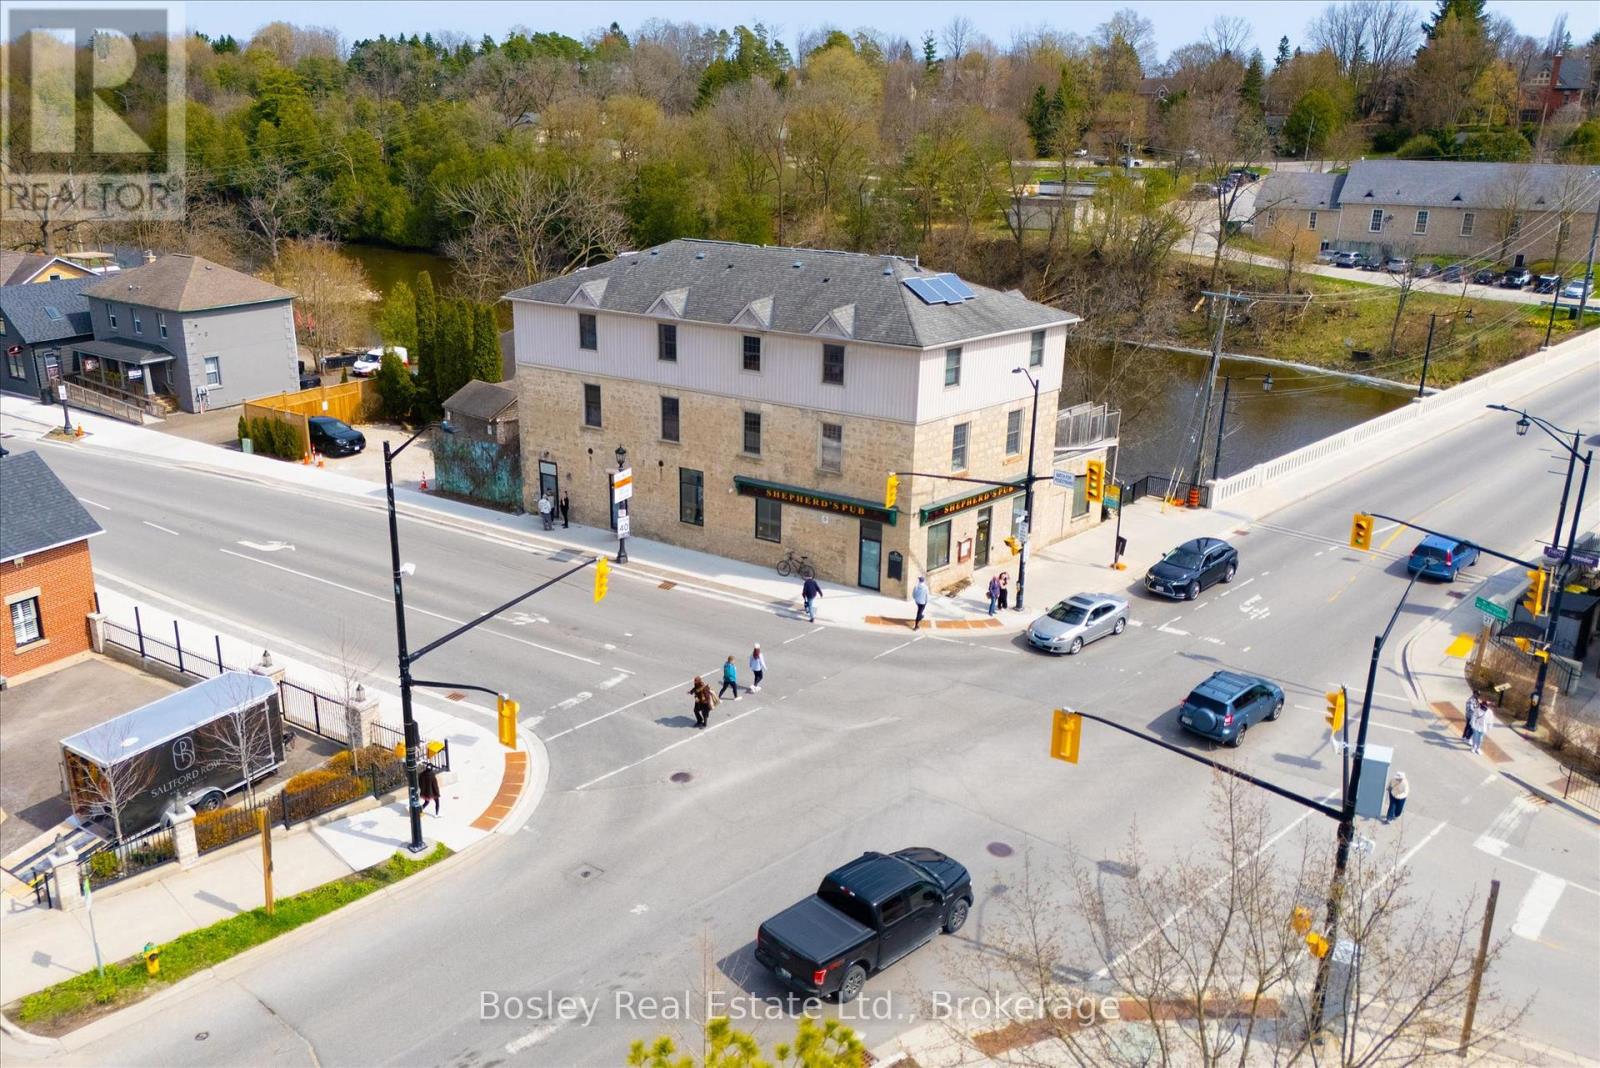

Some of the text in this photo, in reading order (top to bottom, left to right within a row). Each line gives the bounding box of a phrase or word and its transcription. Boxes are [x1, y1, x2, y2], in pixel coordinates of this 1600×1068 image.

[766, 489, 865, 516] SHEPHERD'S PUB
[943, 485, 1014, 514] SHEPHERD'S PUB
[151, 769, 199, 798] SALTFORD
